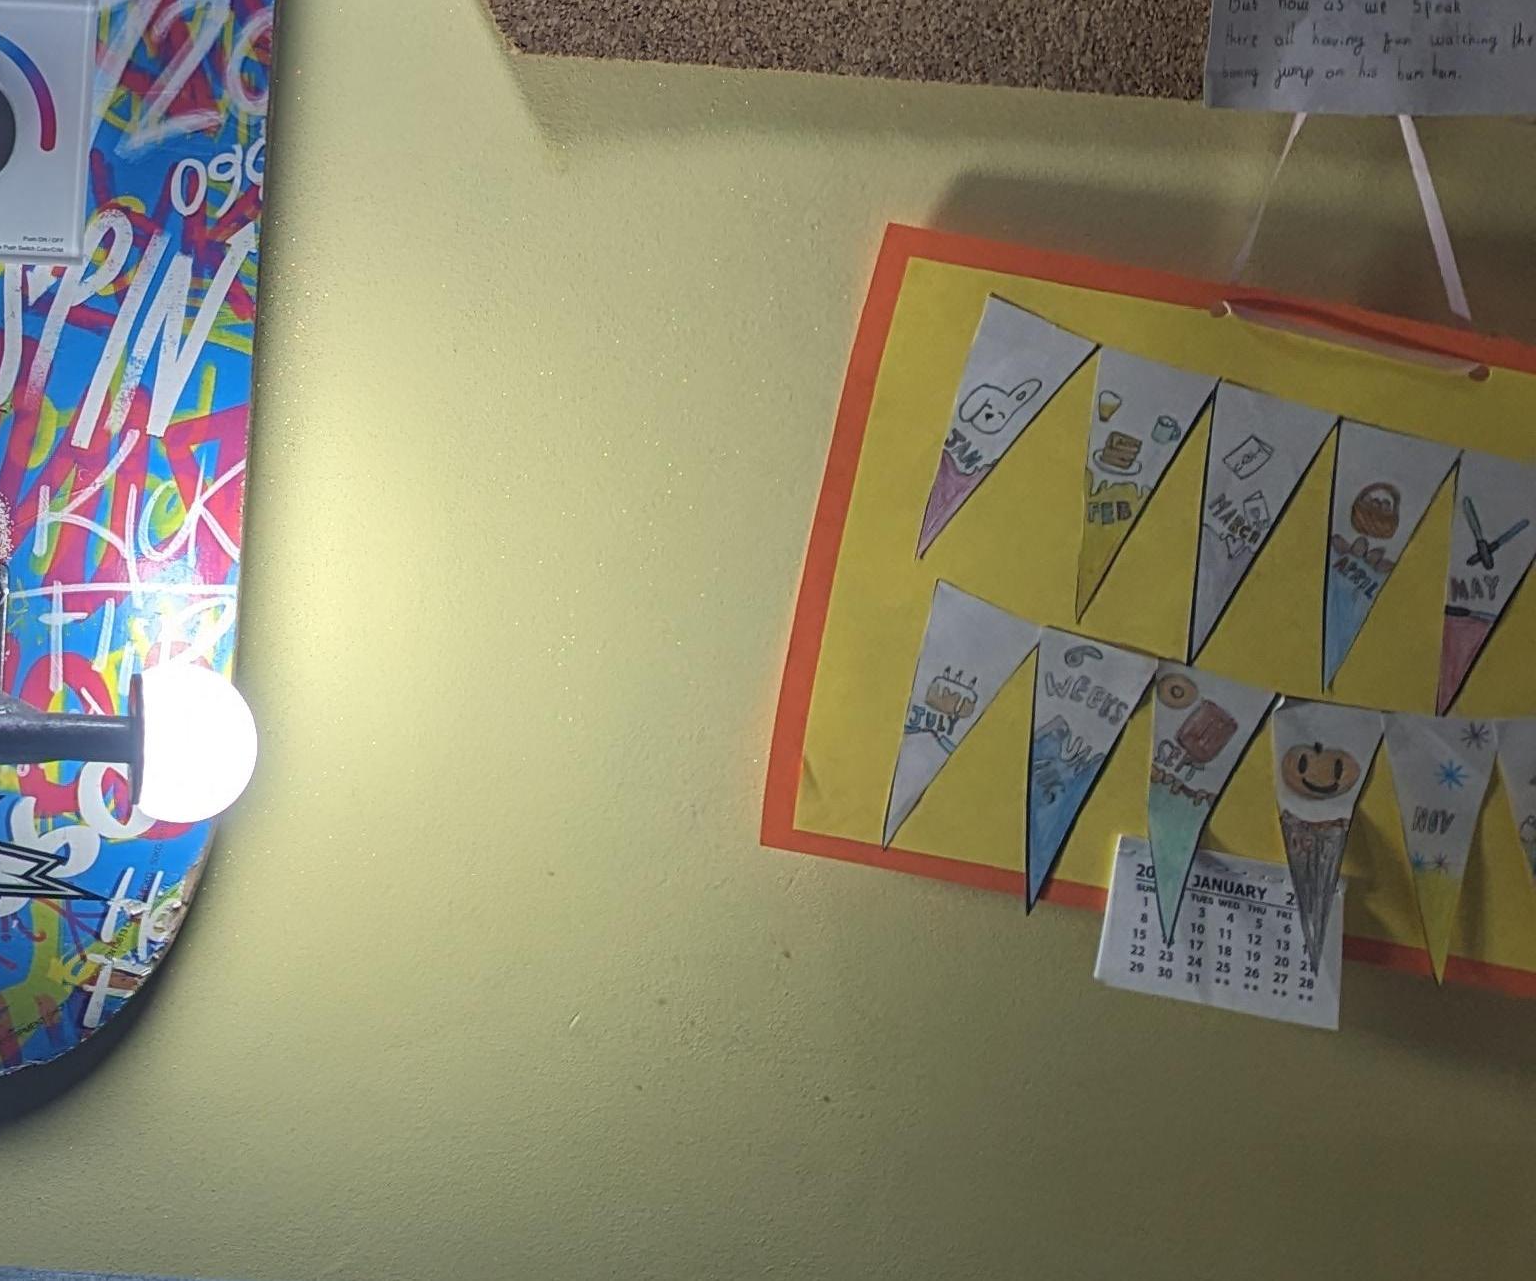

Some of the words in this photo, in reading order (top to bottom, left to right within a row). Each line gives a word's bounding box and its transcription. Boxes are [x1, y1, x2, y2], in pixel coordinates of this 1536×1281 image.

[1274, 59, 1315, 90] jump
[1088, 500, 1133, 525] FEB
[1450, 574, 1499, 603] MAY
[1044, 671, 1131, 728] WEEKS
[1192, 875, 1268, 901] JANUARY
[1143, 897, 1149, 907] 1
[1198, 907, 1206, 918] 3
[1226, 913, 1234, 923] 4
[1256, 918, 1263, 929] 5
[1284, 924, 1292, 934] 6
[1218, 899, 1240, 910] WED
[1248, 905, 1267, 915] THU
[1276, 910, 1292, 920] FRI
[1133, 928, 1147, 940] 15
[1189, 939, 1204, 951] 17
[1218, 945, 1232, 956] 18
[1246, 950, 1261, 962] 19
[1274, 955, 1289, 967] 20
[1191, 923, 1205, 934] 10
[1219, 927, 1232, 940] 11
[1248, 933, 1262, 945] 12
[1276, 939, 1290, 951] 13
[1129, 961, 1144, 973] 29
[1158, 967, 1173, 979] 30
[1186, 972, 1200, 983] 31
[1130, 944, 1145, 956] 22
[1159, 950, 1174, 962] 23
[1187, 955, 1202, 968] 24
[1216, 961, 1231, 973] 25
[1244, 967, 1260, 979] 26
[1273, 972, 1288, 984] 27
[1299, 978, 1313, 989] 28
